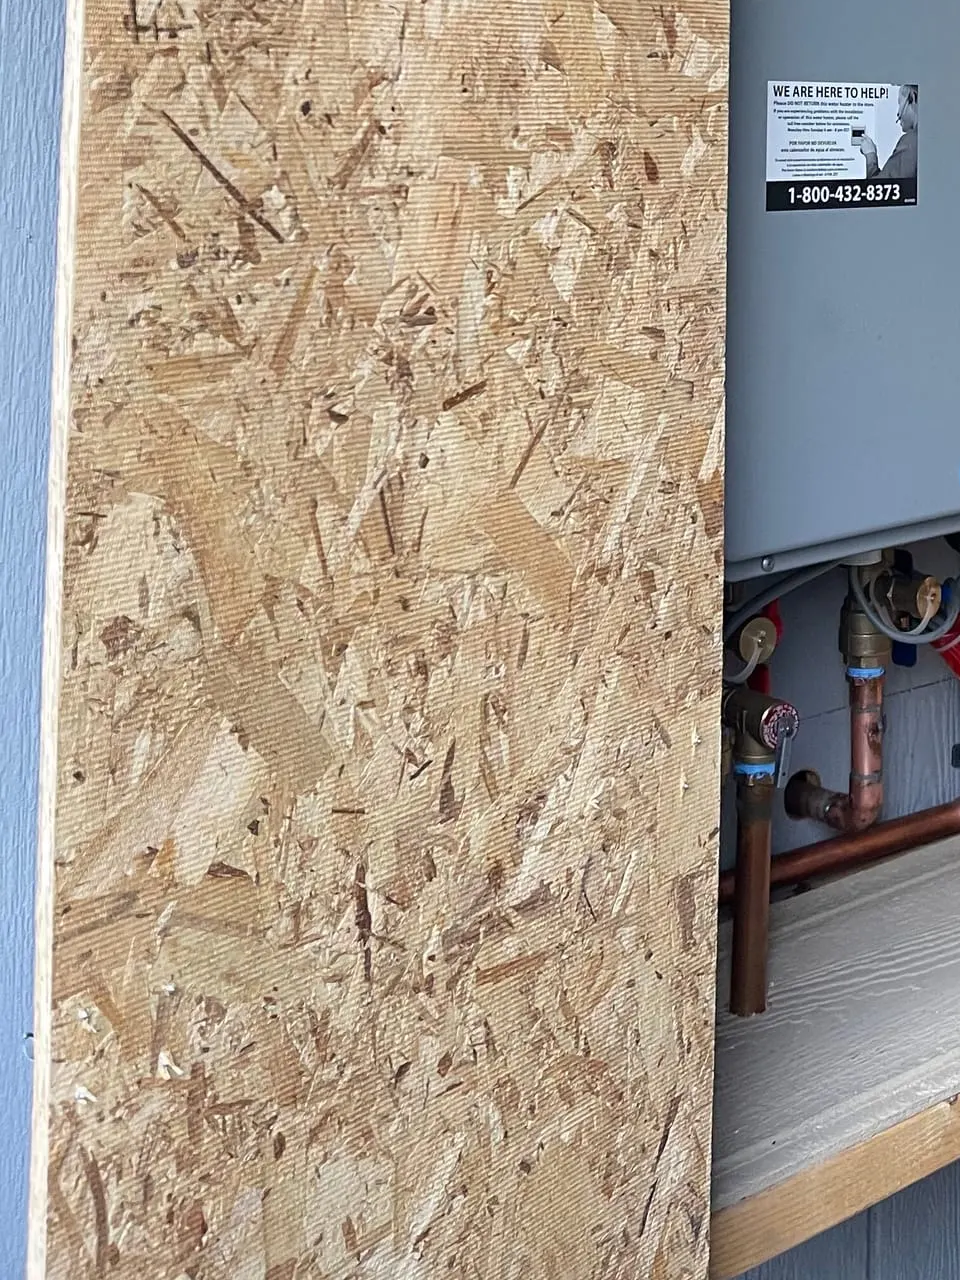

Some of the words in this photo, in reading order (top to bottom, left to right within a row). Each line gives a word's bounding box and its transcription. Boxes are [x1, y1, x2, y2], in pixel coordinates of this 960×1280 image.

[773, 85, 790, 98] WE
[792, 85, 814, 98] ARE
[815, 86, 843, 98] HERE
[844, 86, 858, 99] TO
[860, 87, 889, 99] HELP!
[788, 184, 900, 203] 1-800-432-8373
